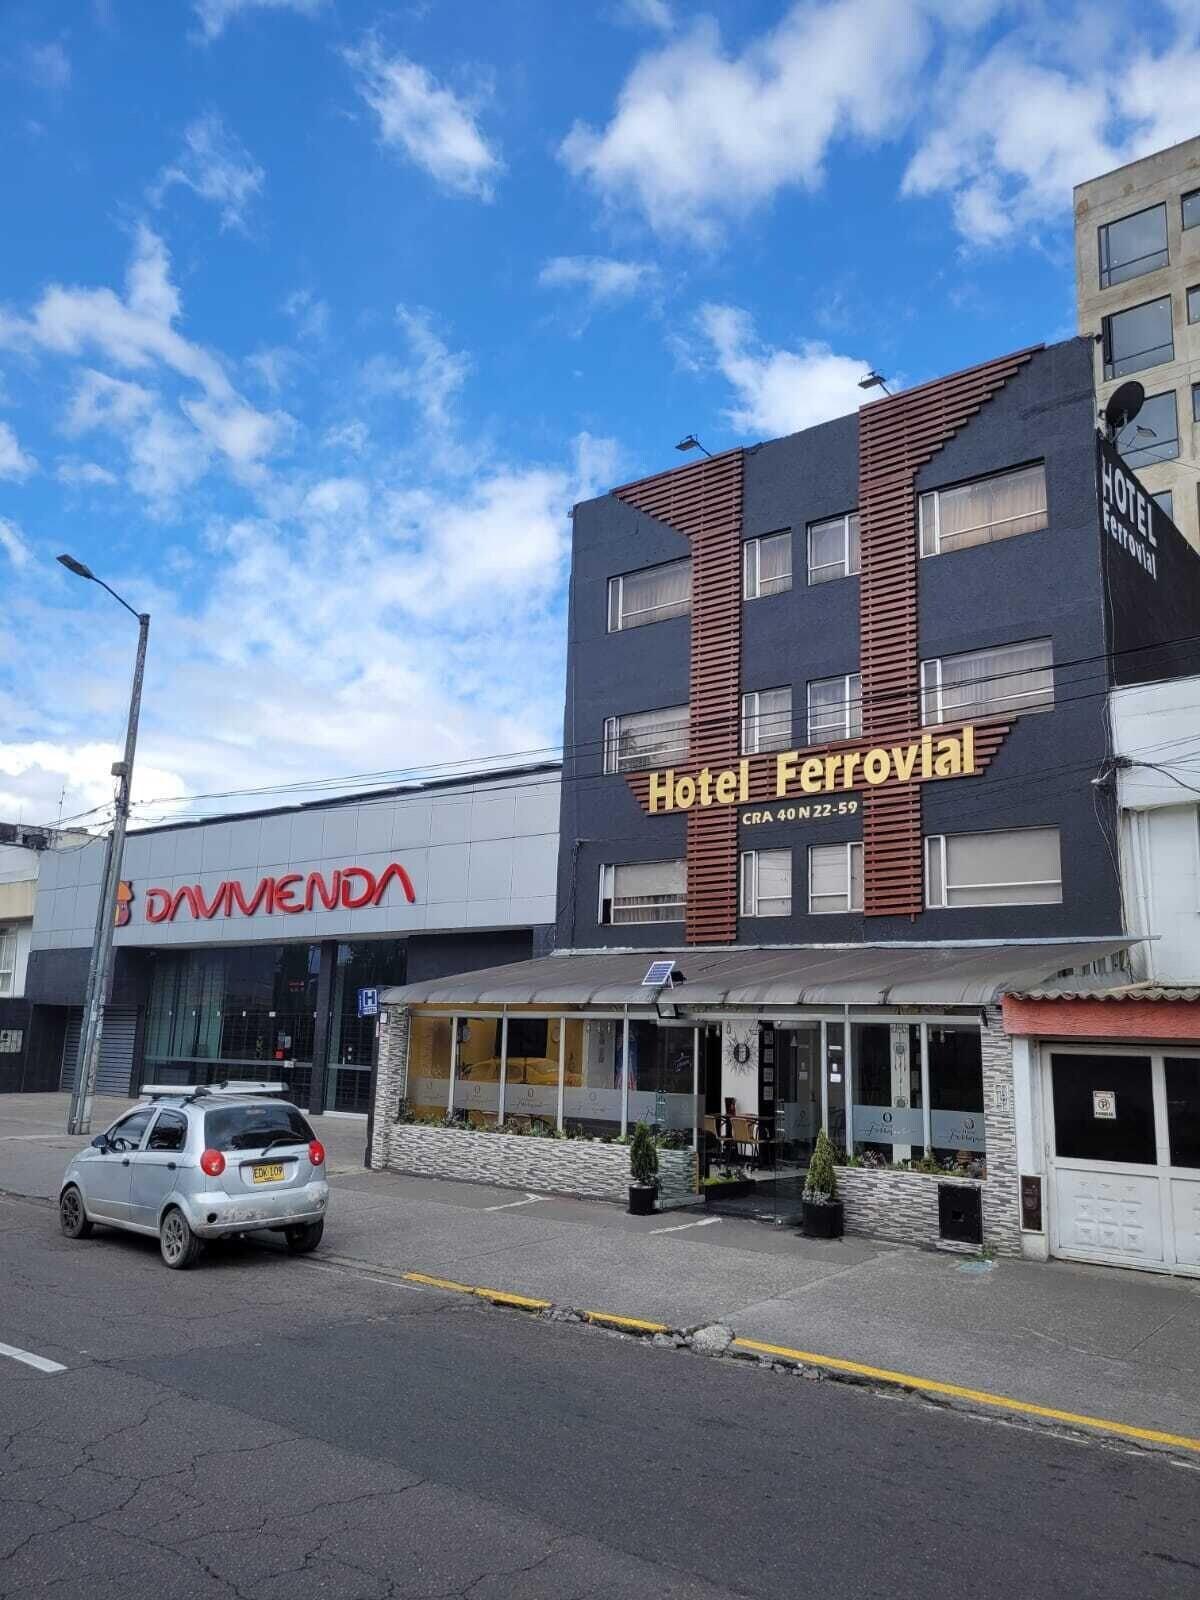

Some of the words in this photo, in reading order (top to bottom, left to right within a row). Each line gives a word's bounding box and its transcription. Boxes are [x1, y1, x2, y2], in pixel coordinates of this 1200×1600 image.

[1102, 456, 1157, 547] HOTEL
[649, 759, 749, 814] Hotel
[776, 724, 976, 798] Ferrovial
[742, 812, 774, 825] CRA
[777, 808, 796, 821] 40
[798, 805, 811, 819] N
[812, 800, 859, 818] 22-59
[146, 862, 416, 923] DAVIVIENDA
[364, 991, 376, 1005] H
